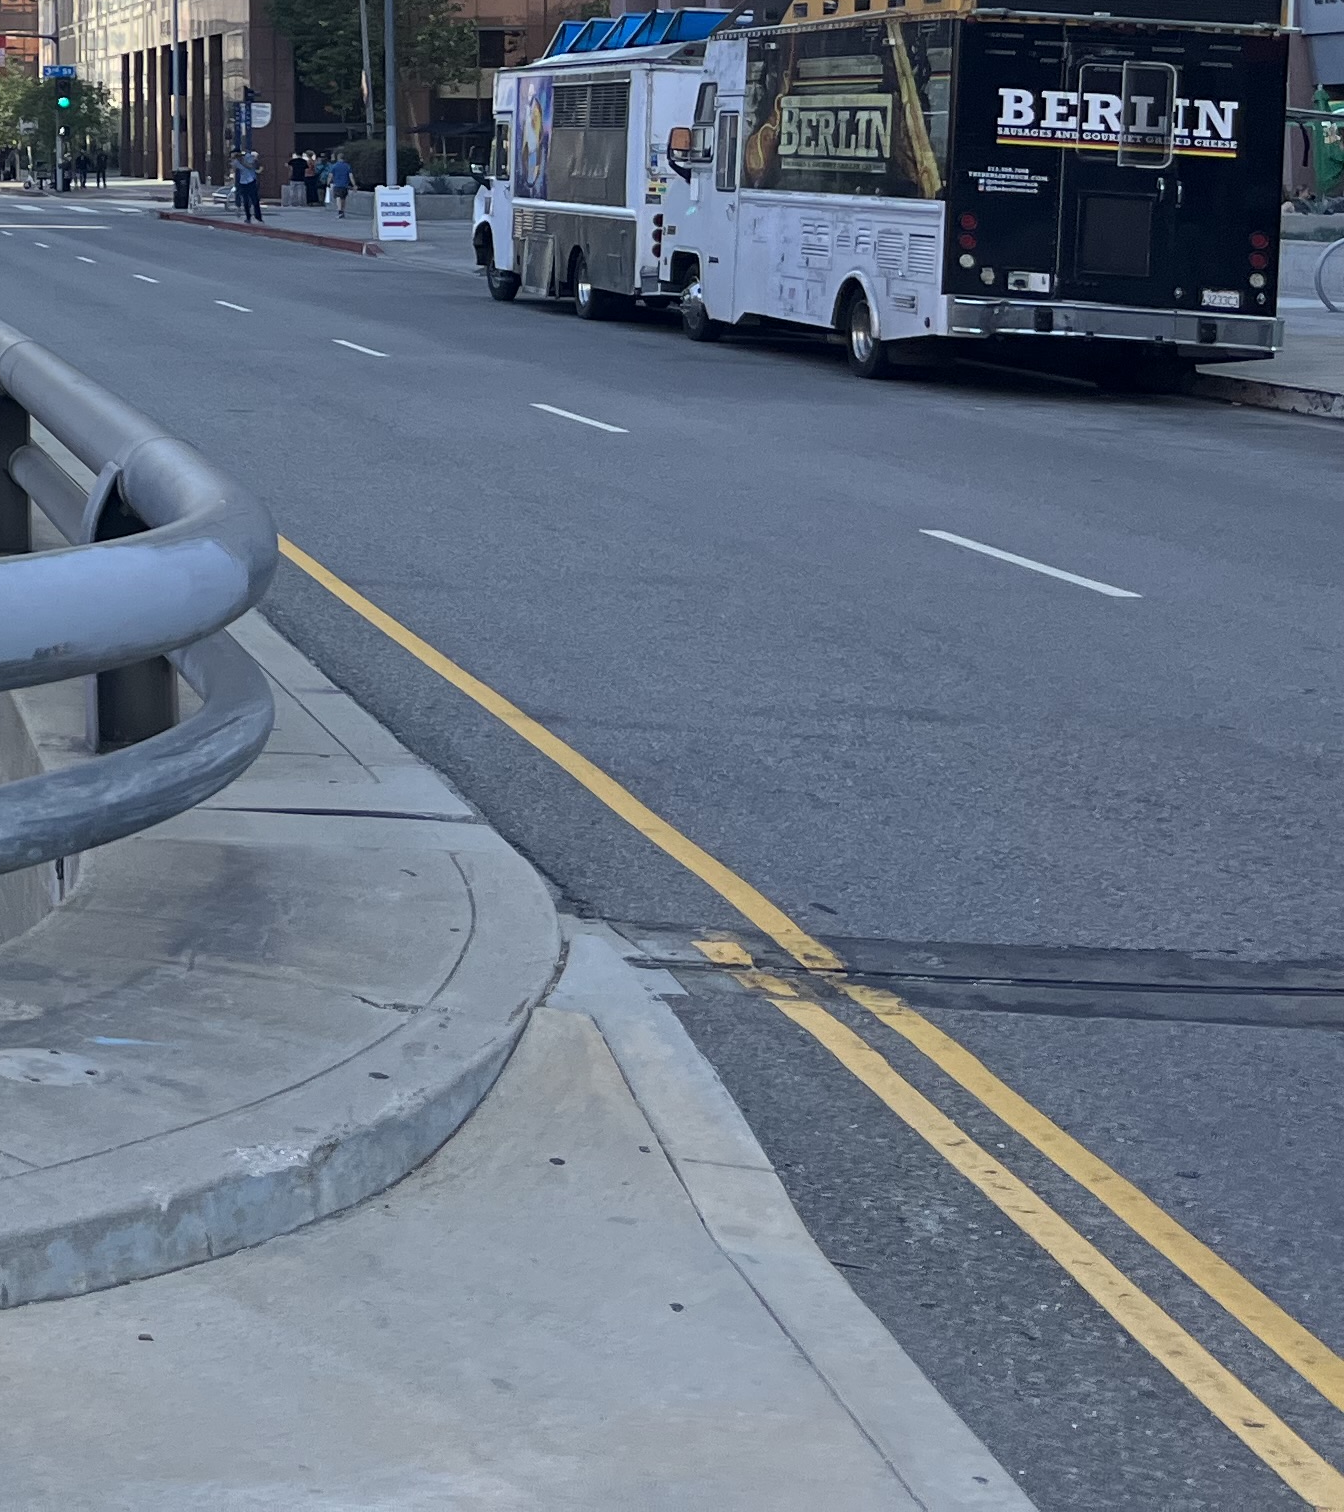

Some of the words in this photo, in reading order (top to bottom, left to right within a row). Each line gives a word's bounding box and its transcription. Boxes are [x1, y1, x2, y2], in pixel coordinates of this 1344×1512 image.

[778, 105, 891, 158] BERLIN
[997, 88, 1239, 138] BERLIN
[997, 127, 1052, 138] SAUSAGES
[1055, 129, 1079, 139] AND
[1194, 139, 1238, 149] CHEESE
